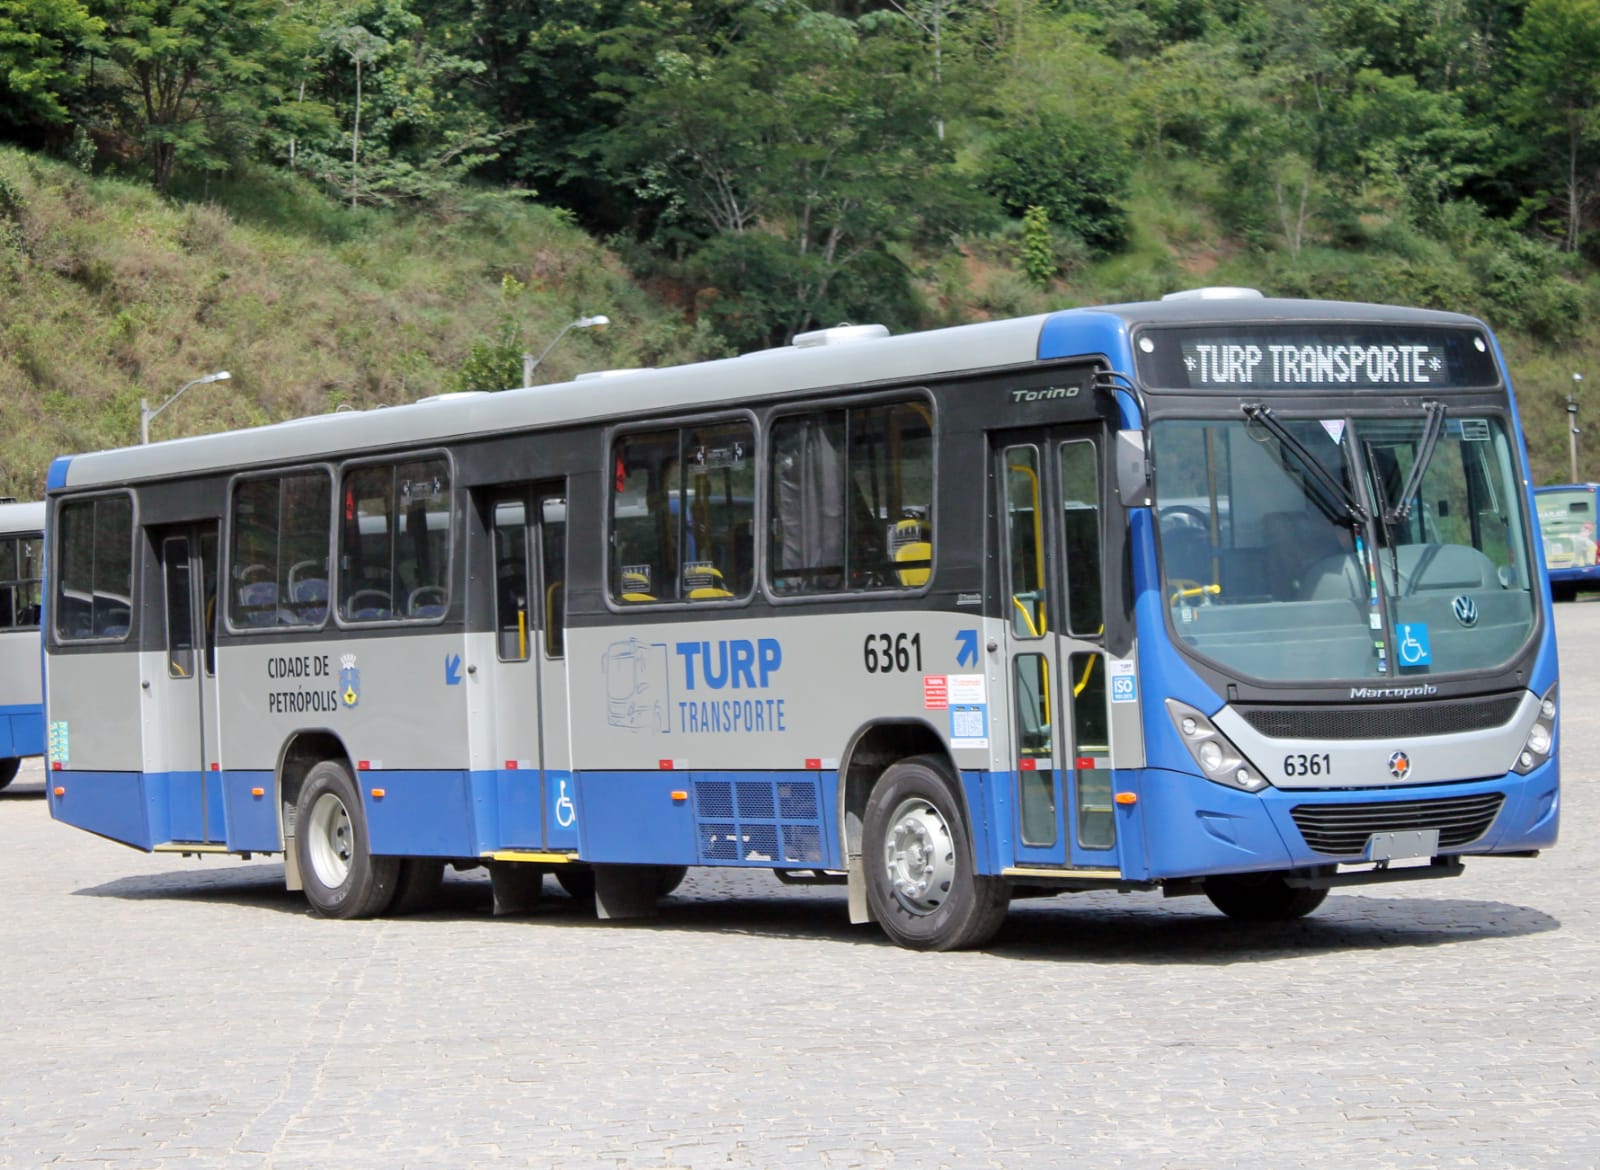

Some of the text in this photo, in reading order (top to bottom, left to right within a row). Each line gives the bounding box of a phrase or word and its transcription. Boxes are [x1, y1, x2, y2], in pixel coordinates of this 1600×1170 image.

[1012, 386, 1080, 403] Torino
[675, 638, 782, 690] TURP
[864, 632, 922, 673] 6361
[267, 655, 330, 679] CIDADE DE
[1114, 679, 1133, 693] ISO
[1350, 684, 1438, 699] Marcopolo
[268, 684, 338, 713] PETRÓPOLIS
[678, 699, 786, 733] TRANSPORTE
[1283, 753, 1331, 777] 6361
